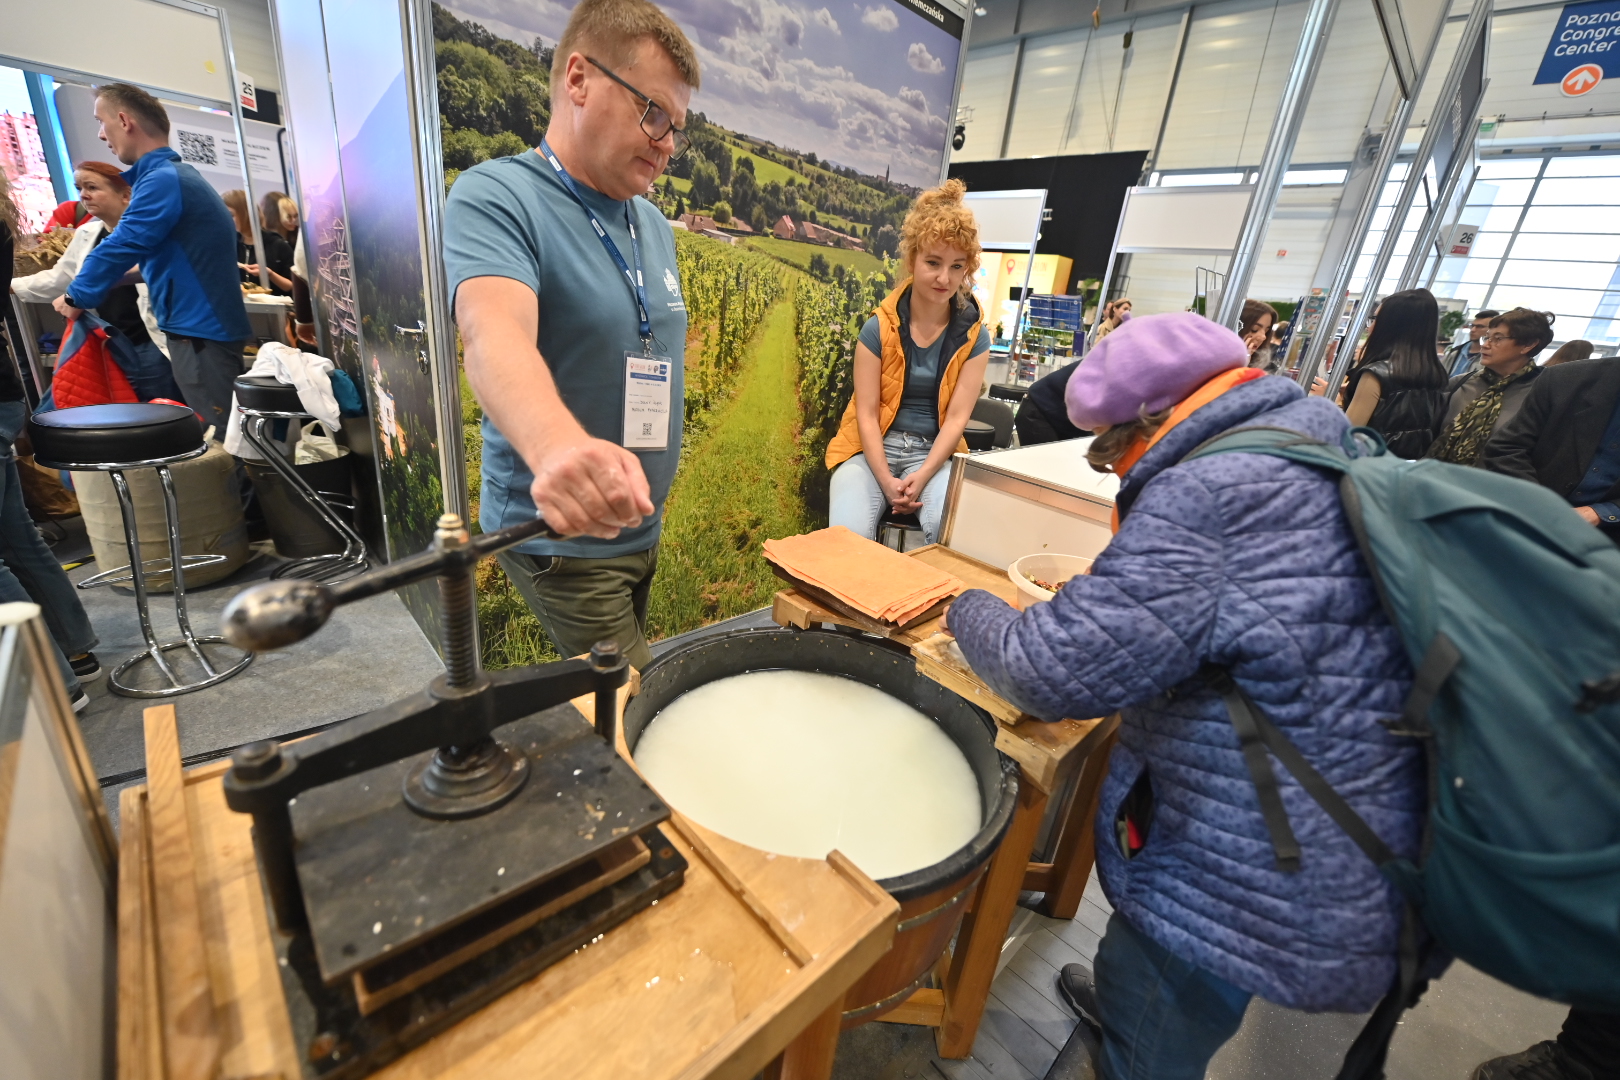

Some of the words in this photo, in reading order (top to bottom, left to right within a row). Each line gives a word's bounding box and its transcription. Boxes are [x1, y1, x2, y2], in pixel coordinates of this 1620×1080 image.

[1565, 11, 1620, 28] Pozna
[1554, 40, 1617, 57] Center
[242, 81, 254, 97] 25
[1459, 231, 1475, 244] 26
